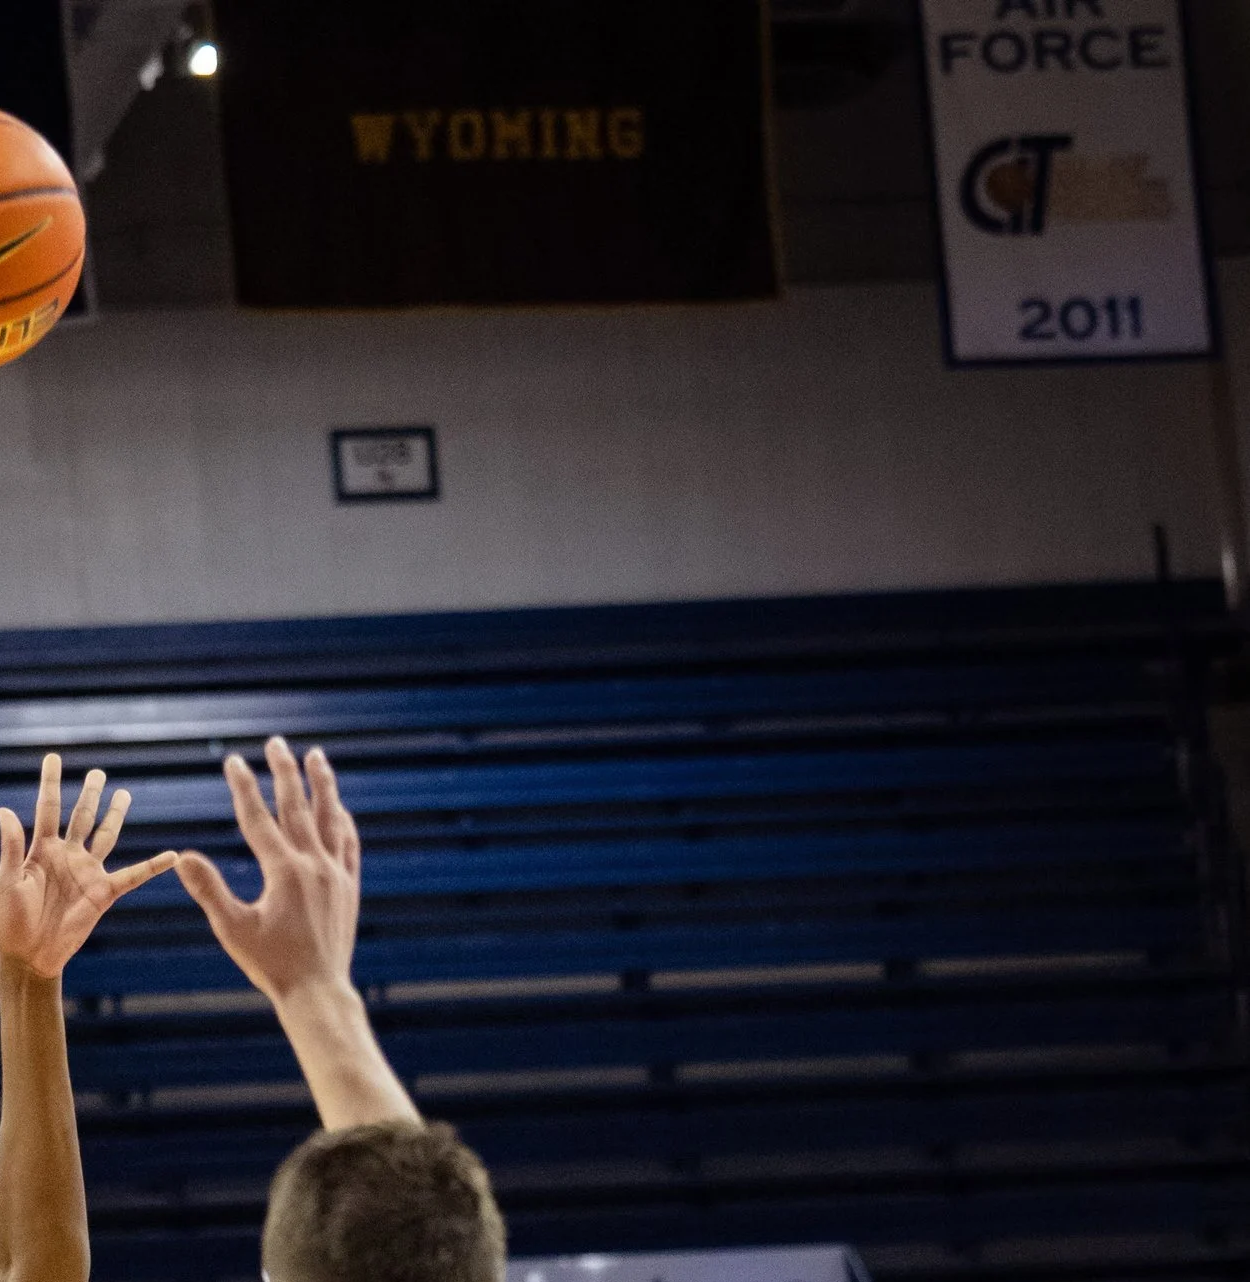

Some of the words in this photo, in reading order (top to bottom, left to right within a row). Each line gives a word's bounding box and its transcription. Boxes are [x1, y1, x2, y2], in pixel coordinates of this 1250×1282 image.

[939, 26, 1173, 76] FORCE
[349, 107, 646, 164] WYOMING
[1017, 296, 1143, 343] 2011
